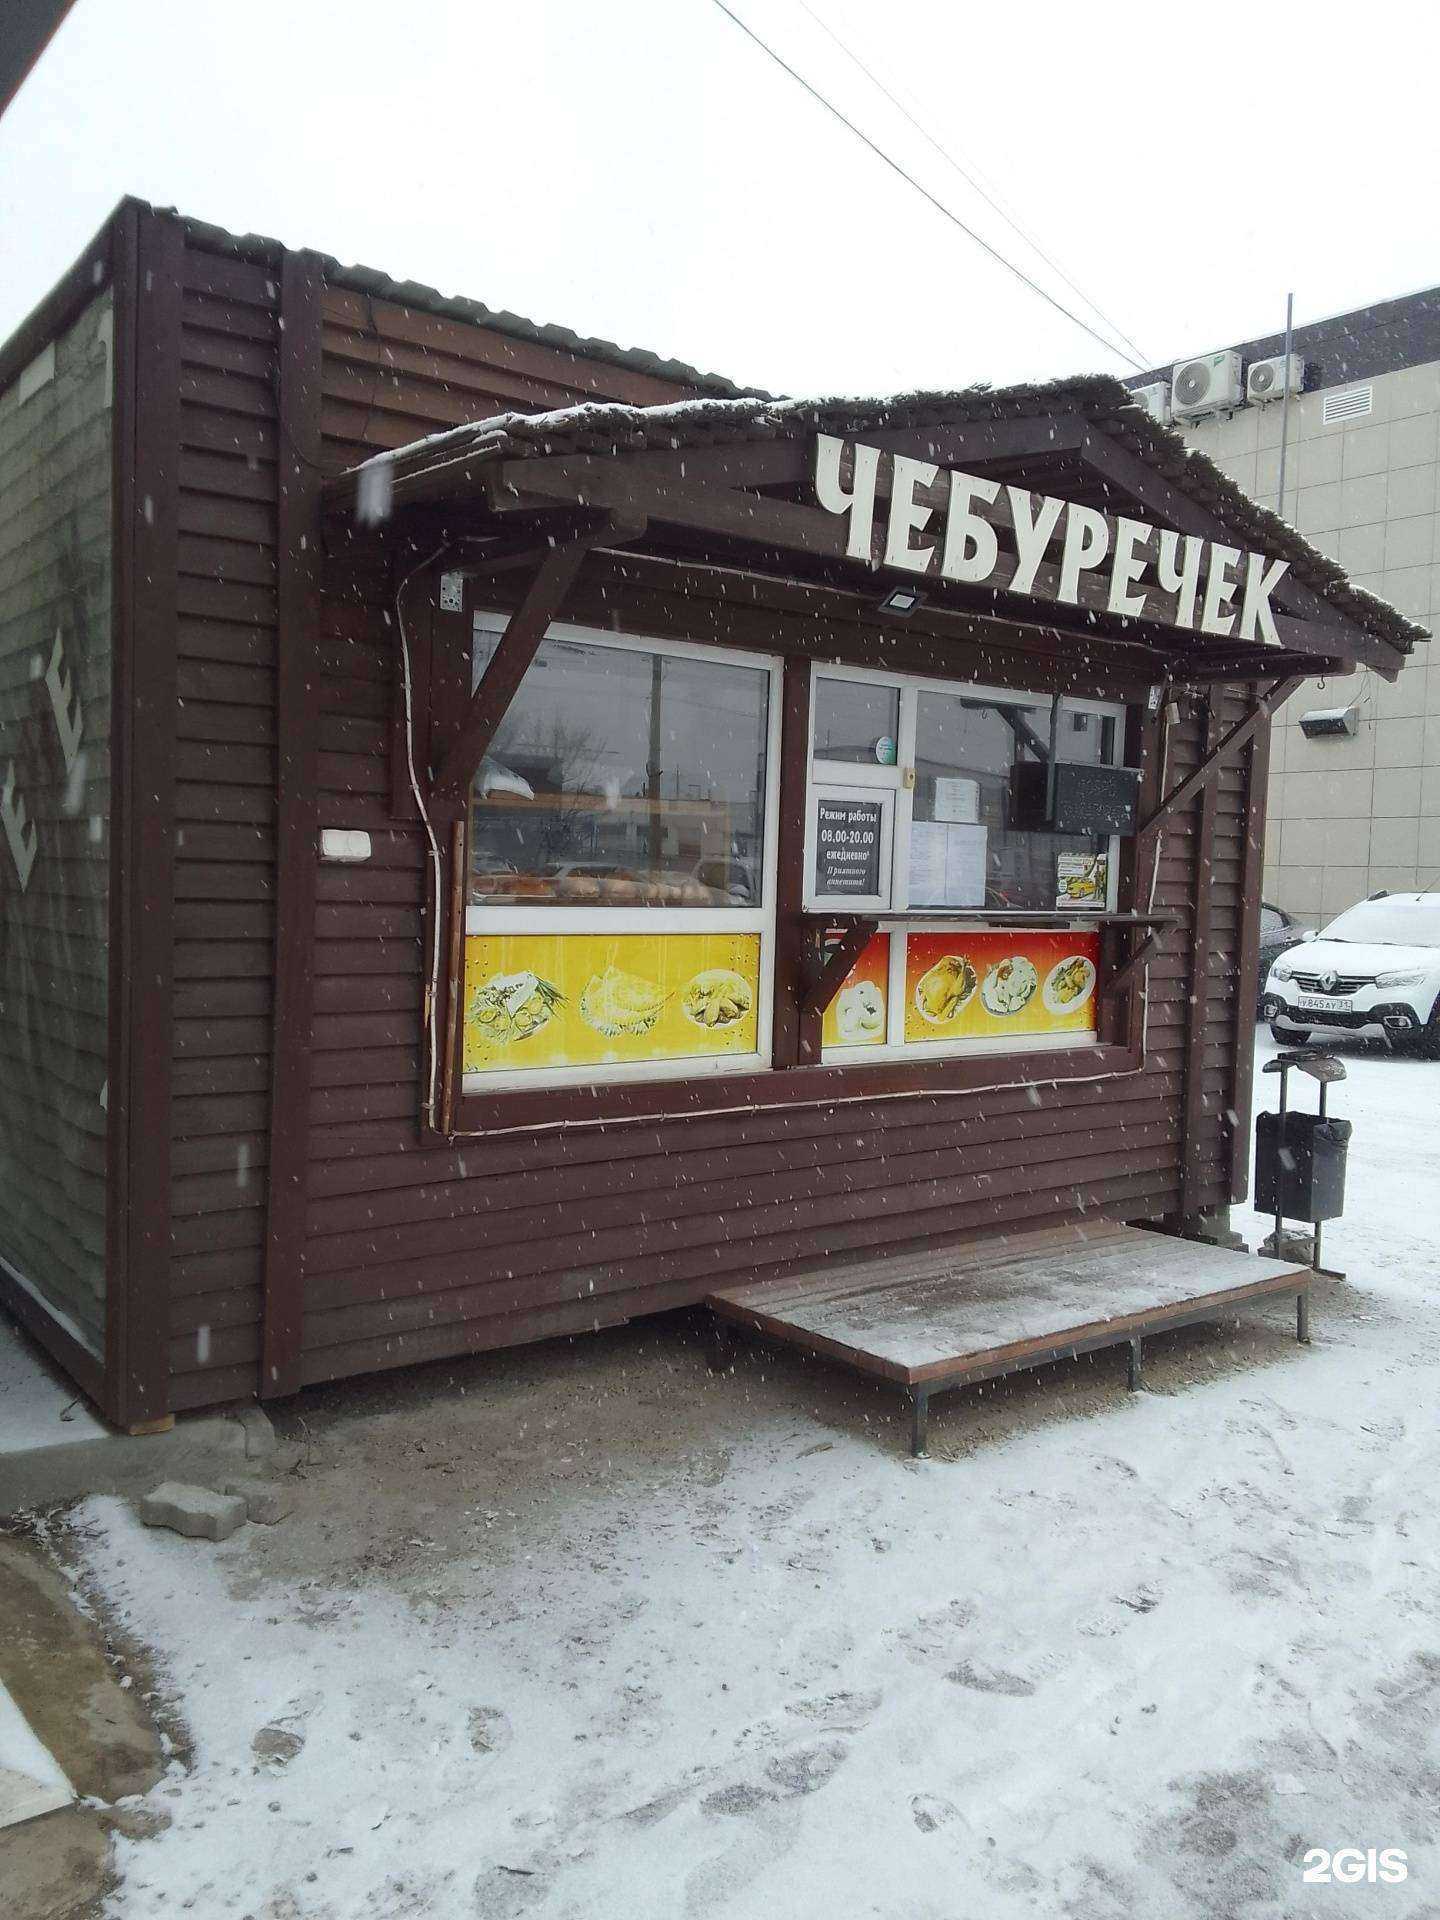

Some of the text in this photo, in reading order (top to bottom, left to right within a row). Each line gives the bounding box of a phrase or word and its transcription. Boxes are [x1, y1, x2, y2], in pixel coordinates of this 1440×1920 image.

[815, 432, 1291, 648] ЧЕБУРЕЧЕК
[820, 807, 877, 823] Режим работы
[821, 830, 874, 843] 08.00-20.00
